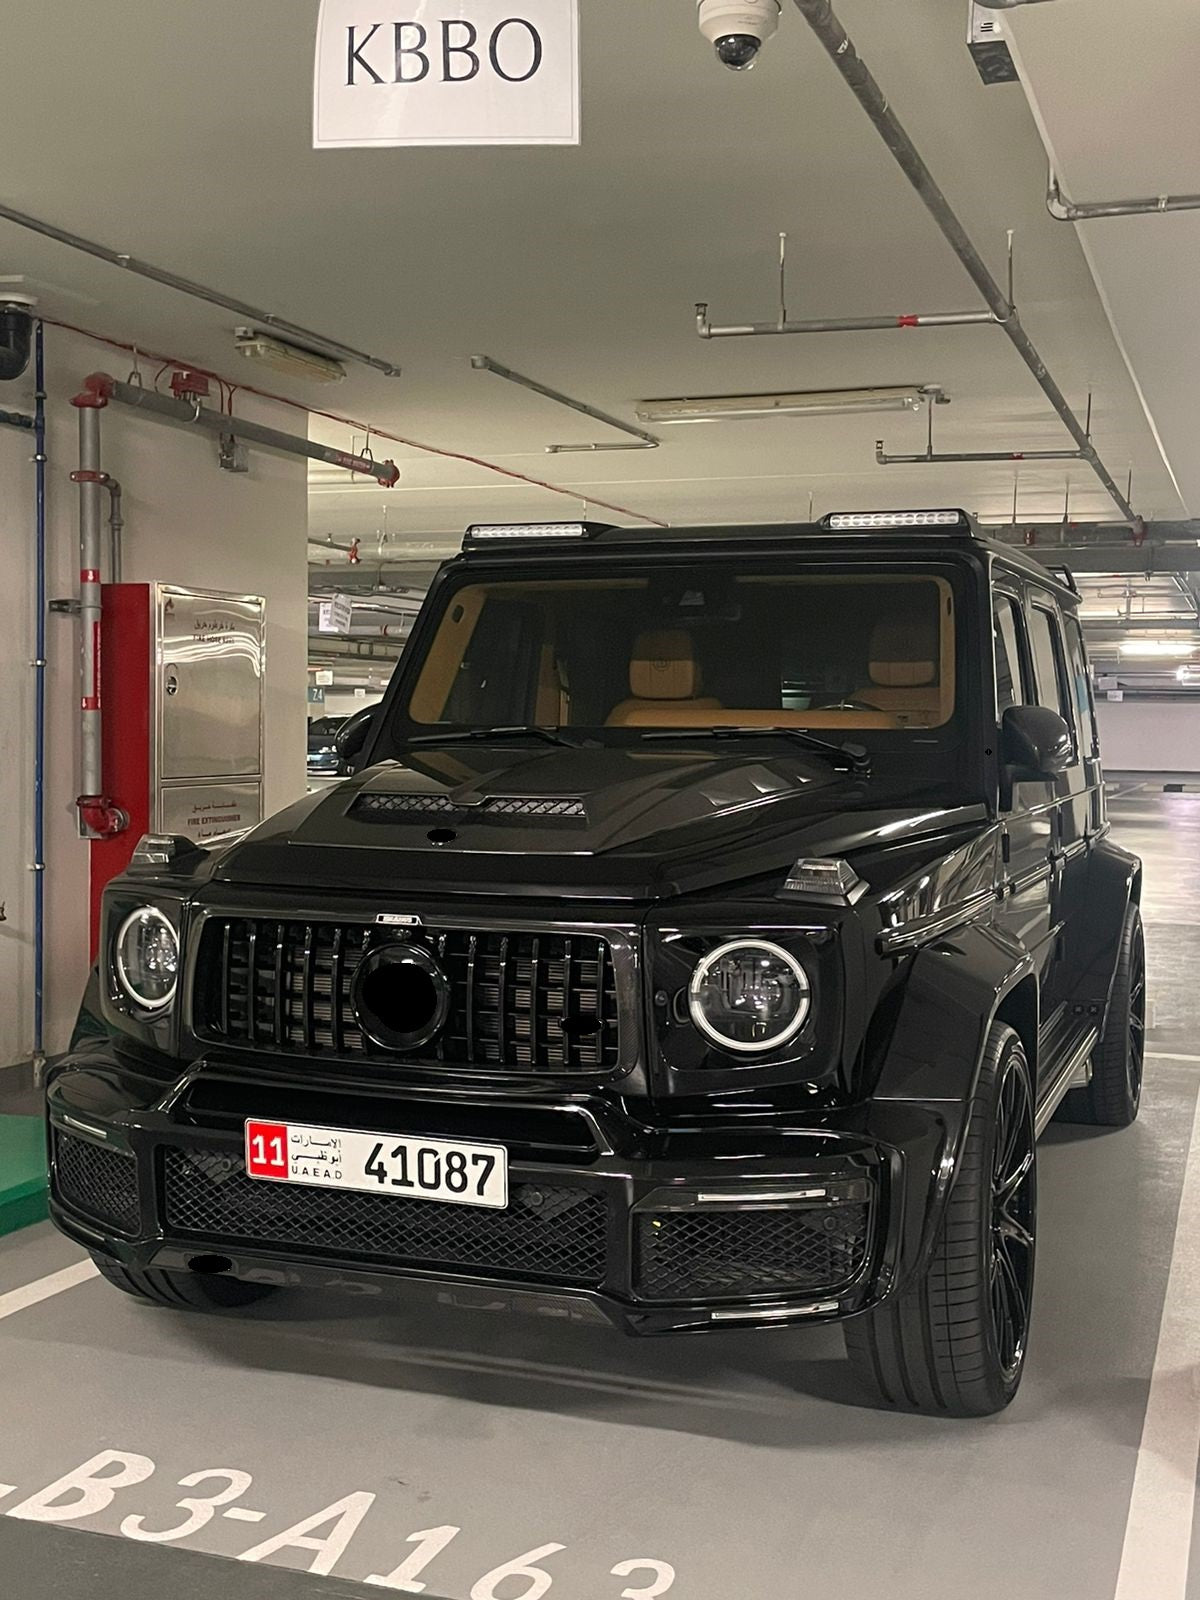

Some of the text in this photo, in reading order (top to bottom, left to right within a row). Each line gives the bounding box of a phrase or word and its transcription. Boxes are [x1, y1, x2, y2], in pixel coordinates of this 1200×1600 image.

[344, 17, 542, 86] KBBO
[252, 1134, 285, 1166] 11
[364, 1142, 496, 1196] 41087
